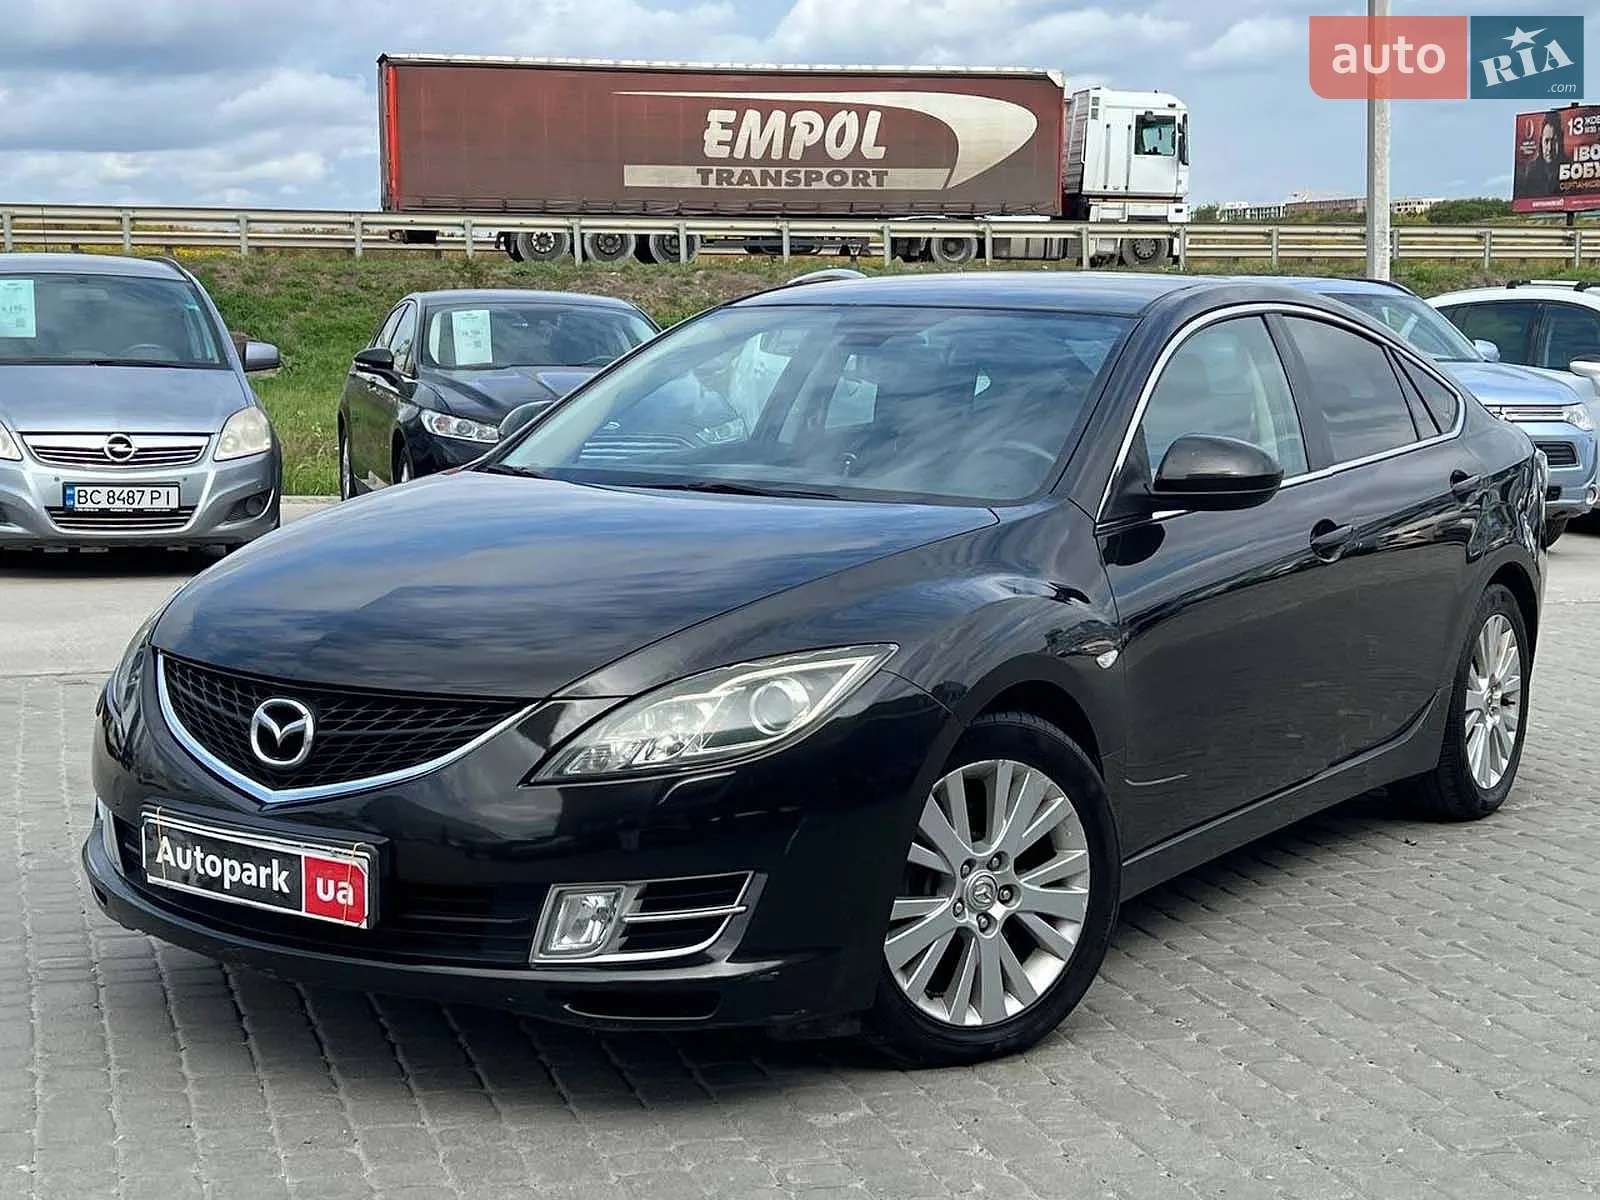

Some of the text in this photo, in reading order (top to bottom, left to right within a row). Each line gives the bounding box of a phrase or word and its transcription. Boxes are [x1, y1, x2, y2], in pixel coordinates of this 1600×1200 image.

[703, 108, 886, 161] EMPOL
[1567, 117, 1584, 136] 13
[696, 166, 889, 189] TRANSPORT
[77, 489, 170, 505] BC 8487 PI
[155, 835, 355, 906] Autopark ua
